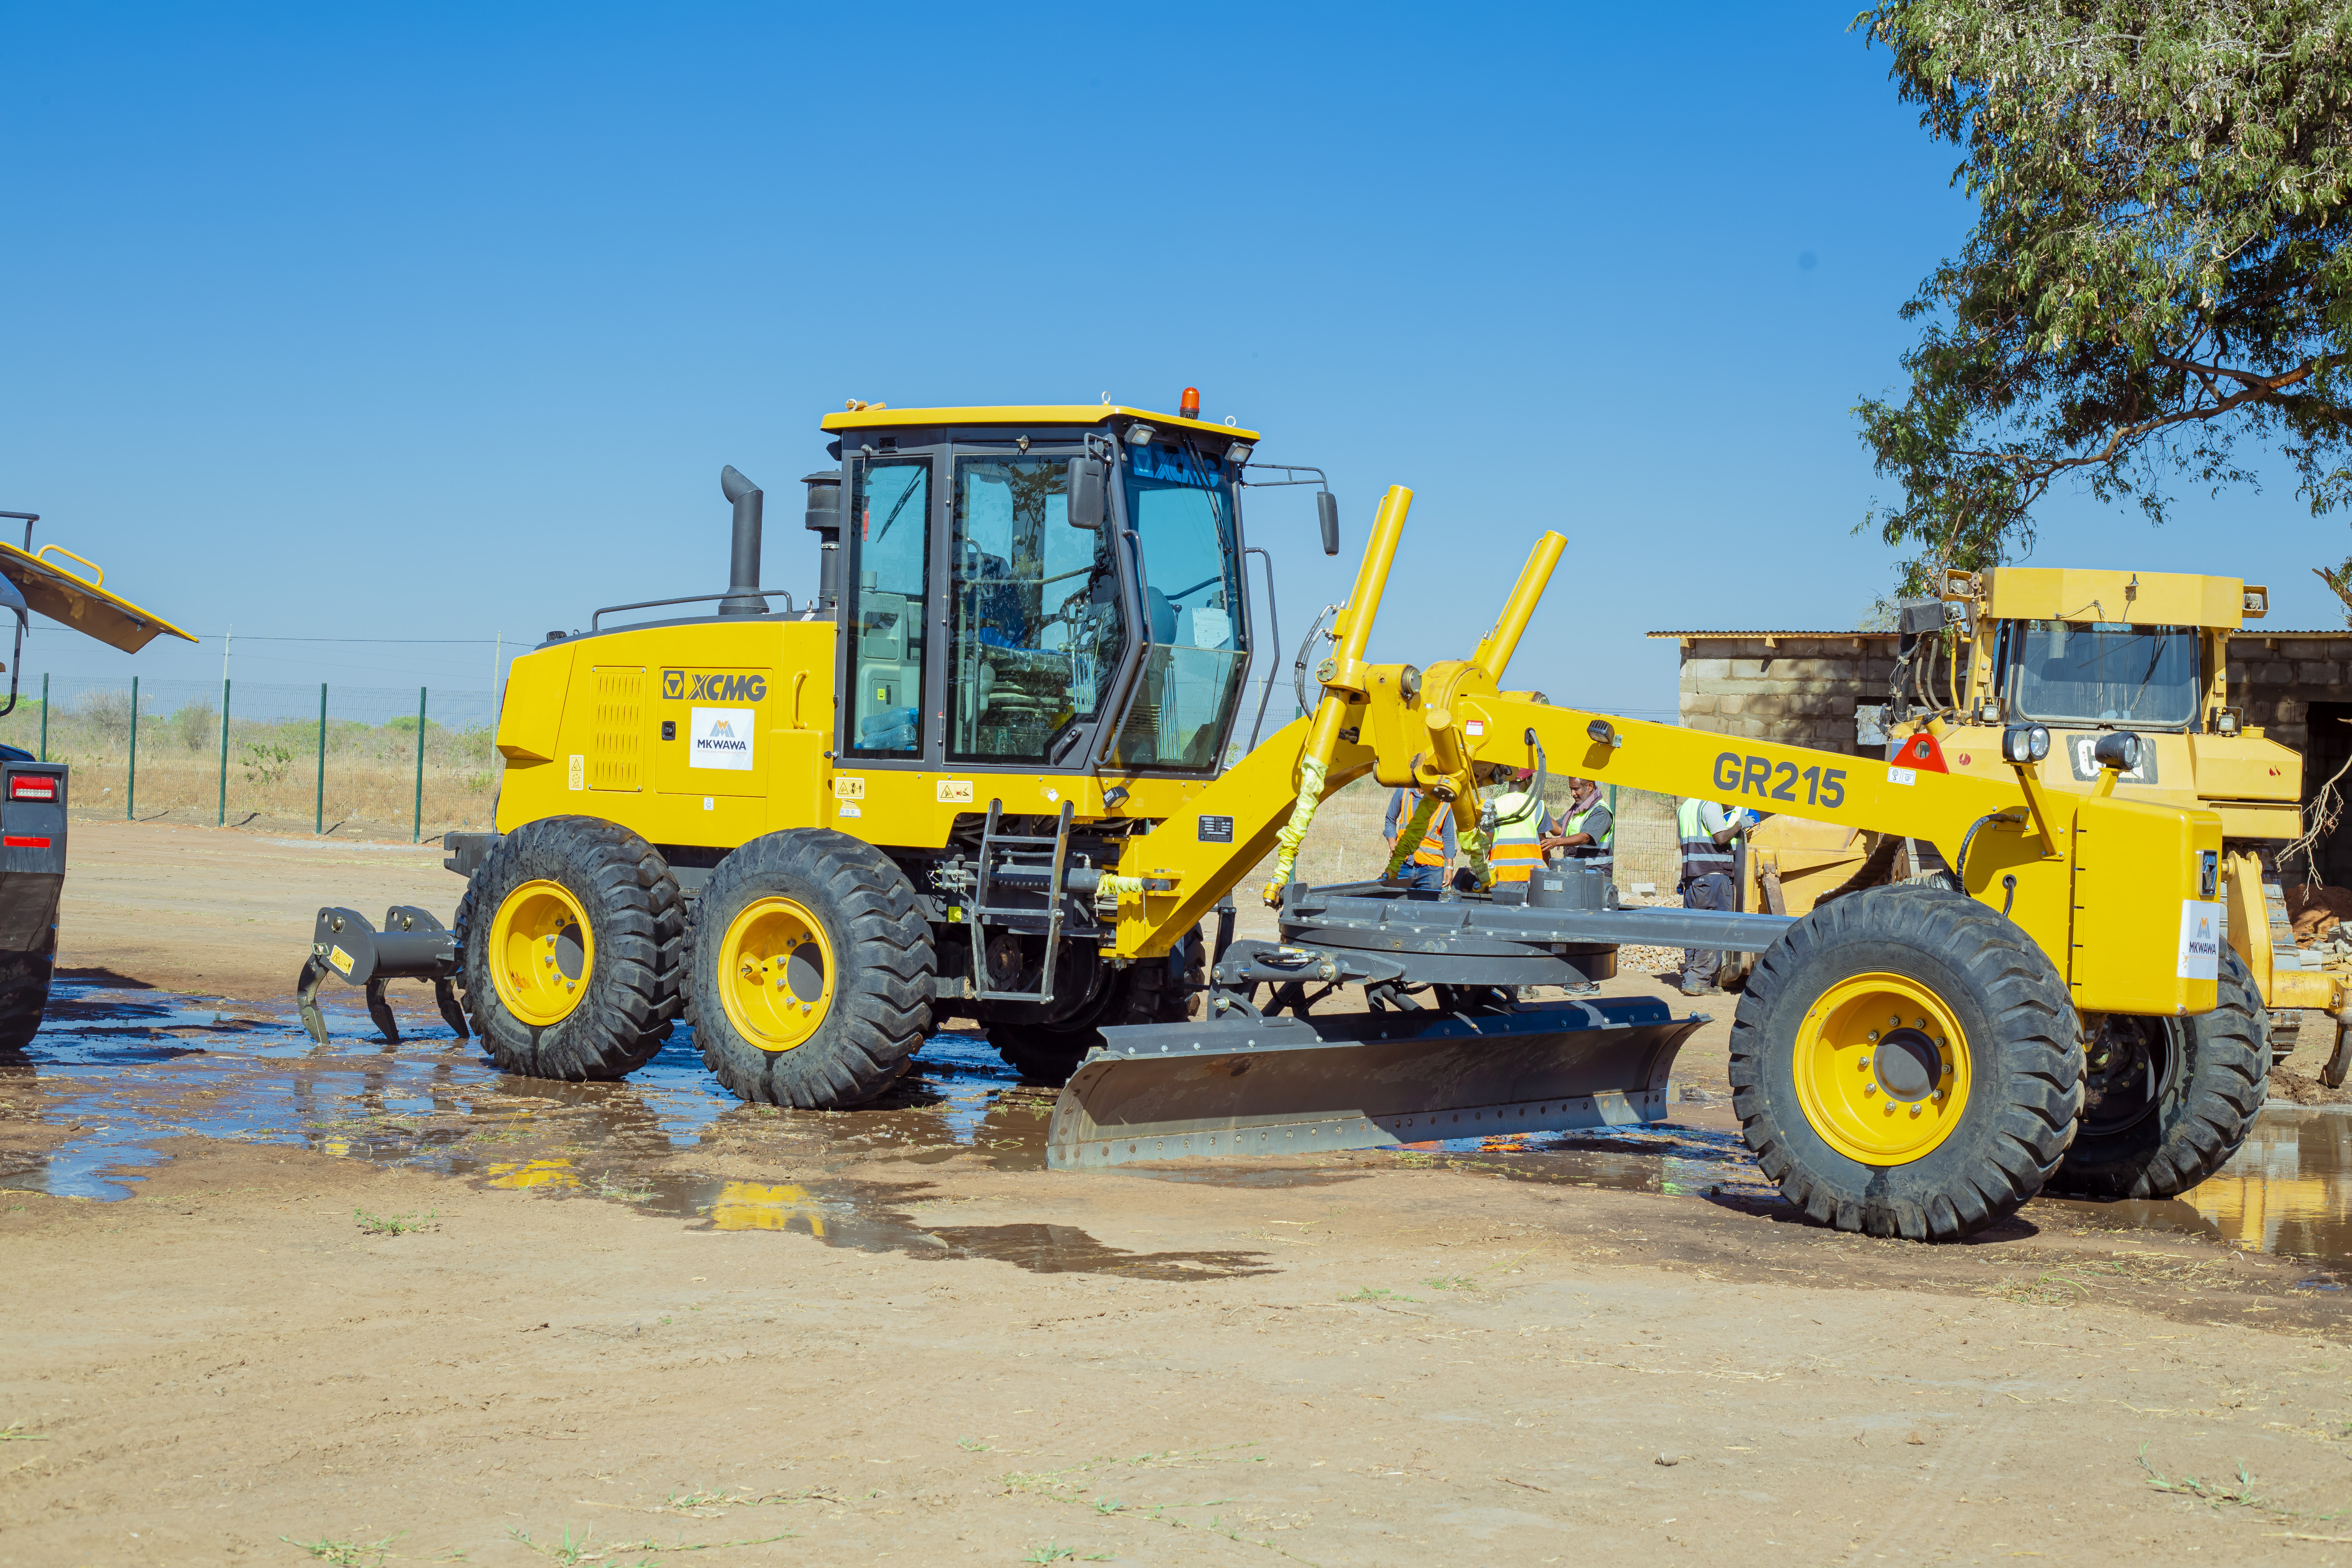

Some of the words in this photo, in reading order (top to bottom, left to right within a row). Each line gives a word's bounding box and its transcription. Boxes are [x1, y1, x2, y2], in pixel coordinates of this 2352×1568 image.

[1154, 451, 1219, 487] XCMG
[686, 674, 767, 702] XCMG
[697, 739, 746, 750] MKWAWA
[1713, 752, 1847, 808] GR215
[2189, 941, 2216, 955] MKWAWA
